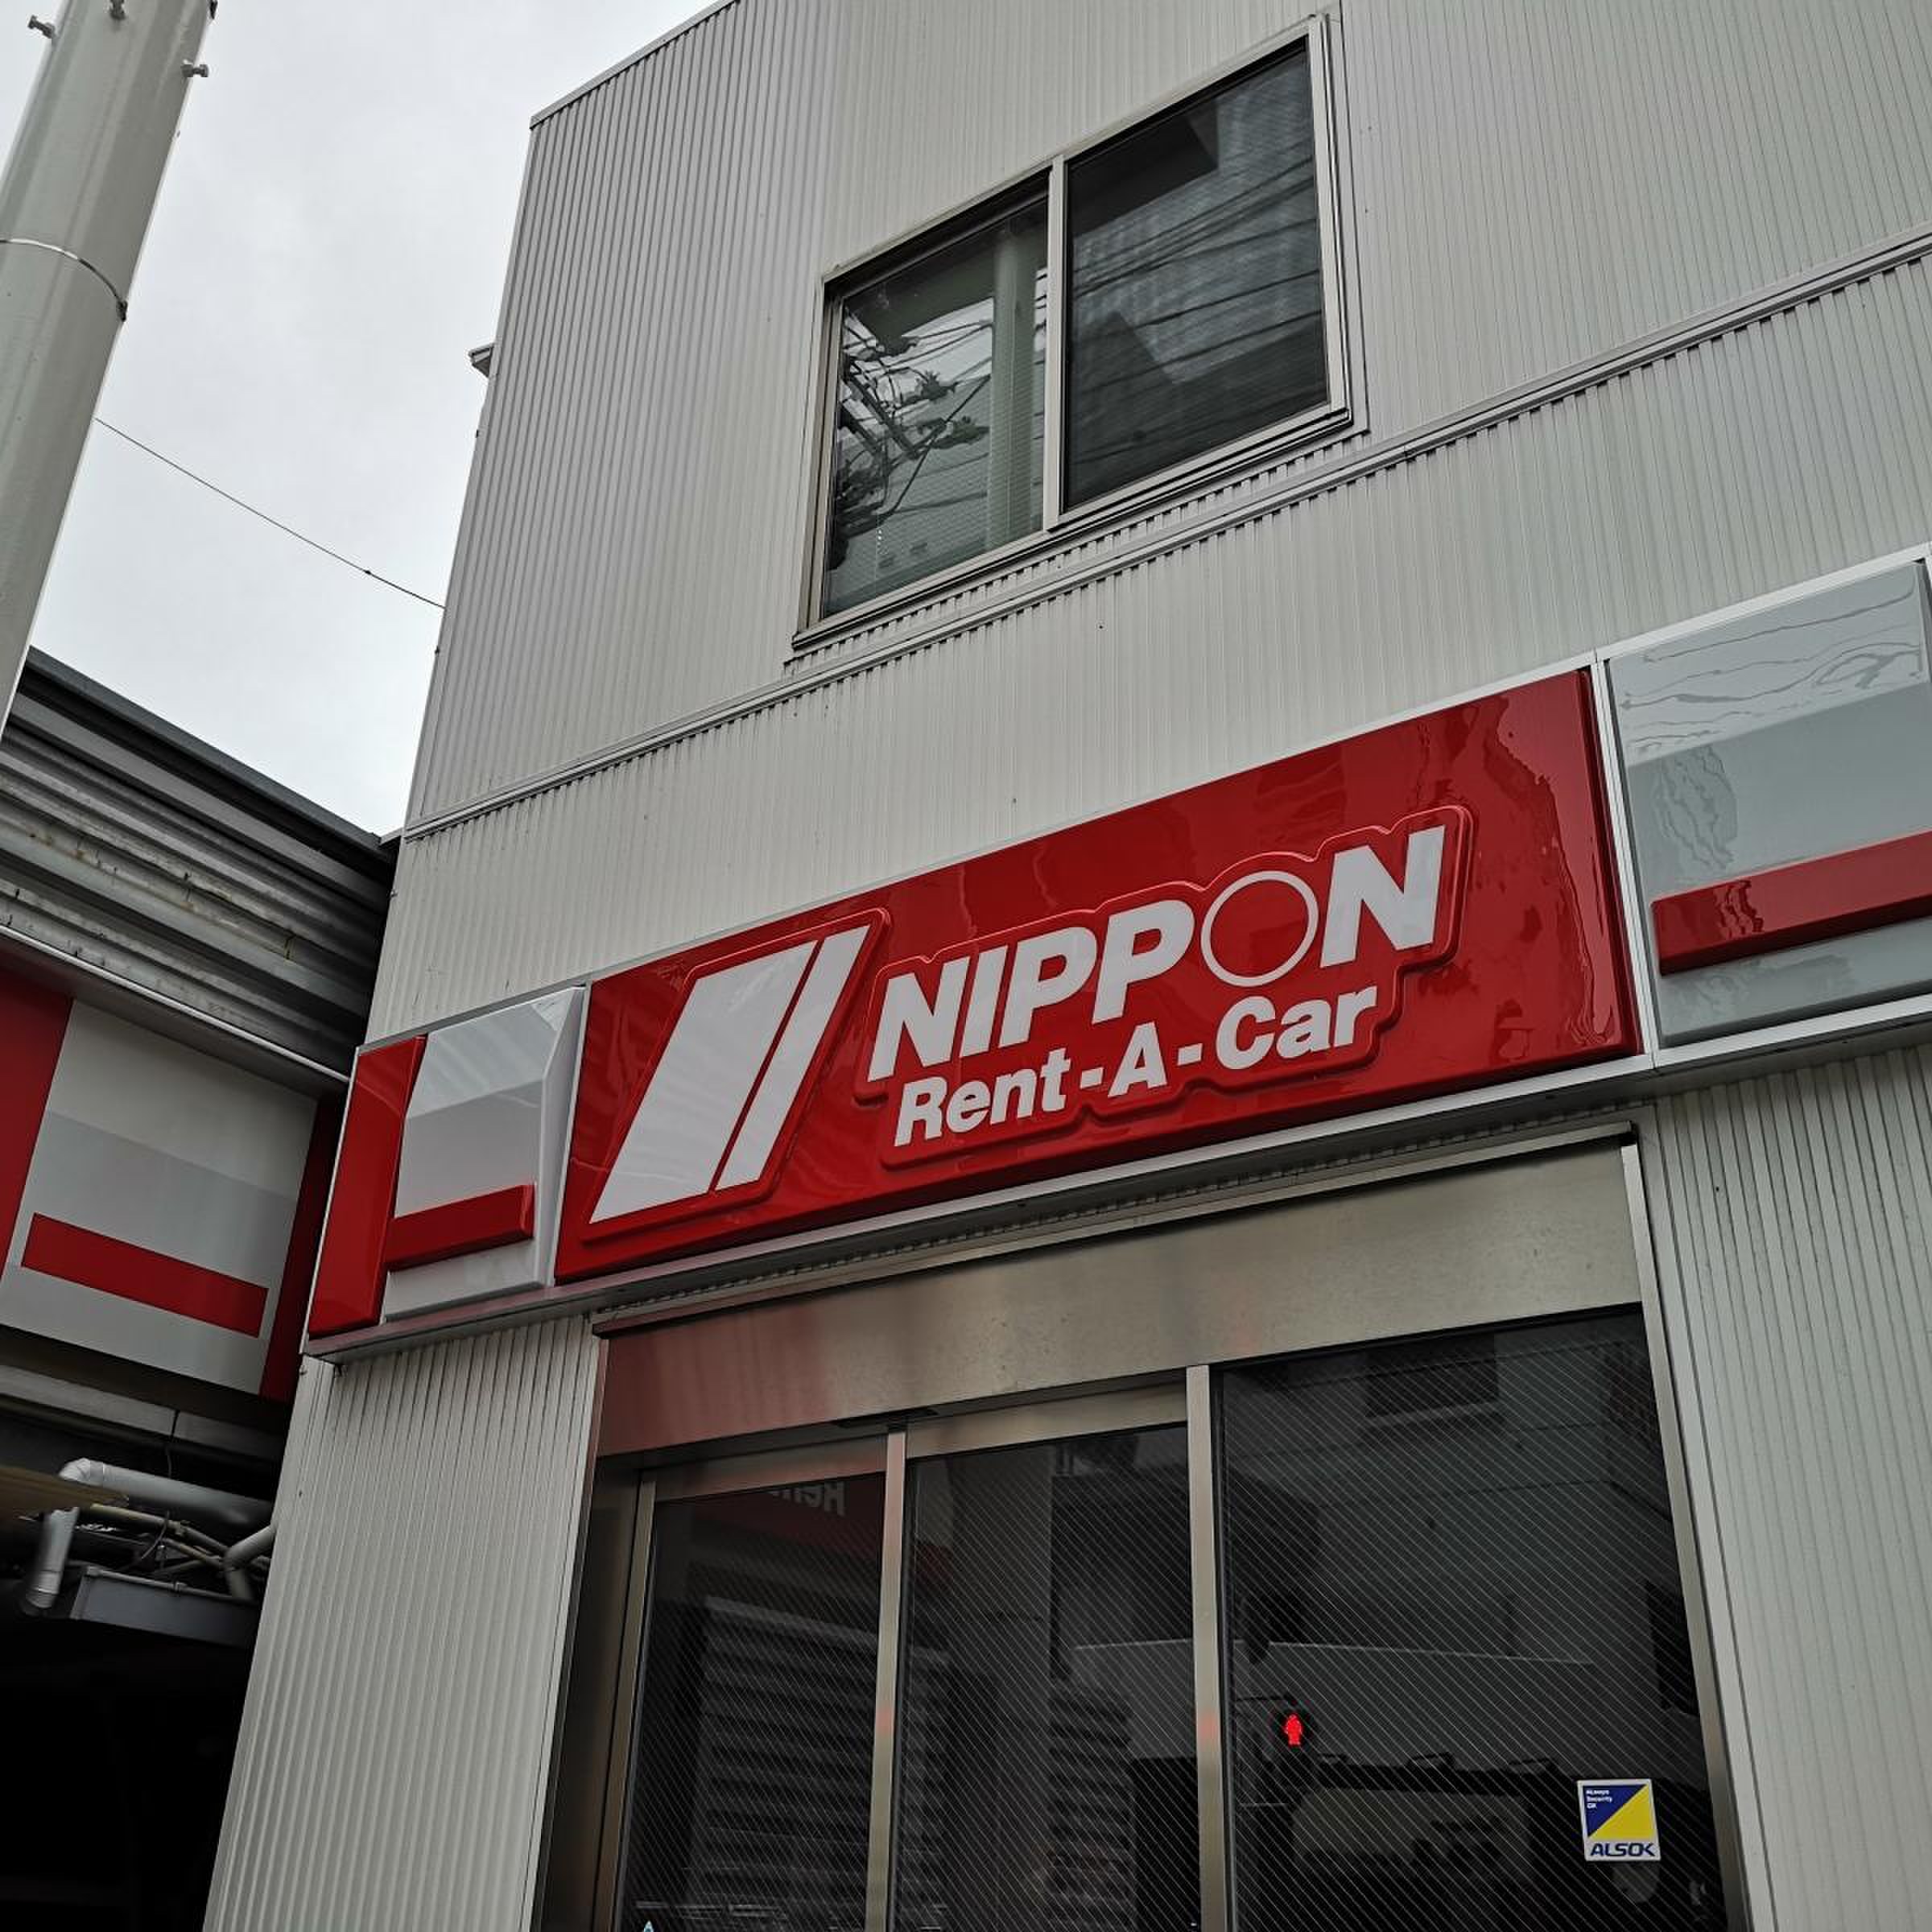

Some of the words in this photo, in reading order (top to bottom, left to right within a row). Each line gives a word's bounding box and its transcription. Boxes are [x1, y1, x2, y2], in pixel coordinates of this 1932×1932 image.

[867, 825, 1446, 1082] NIPPON
[894, 985, 1377, 1147] Rent-A-Car
[1591, 1843, 1655, 1857] ALSOK
